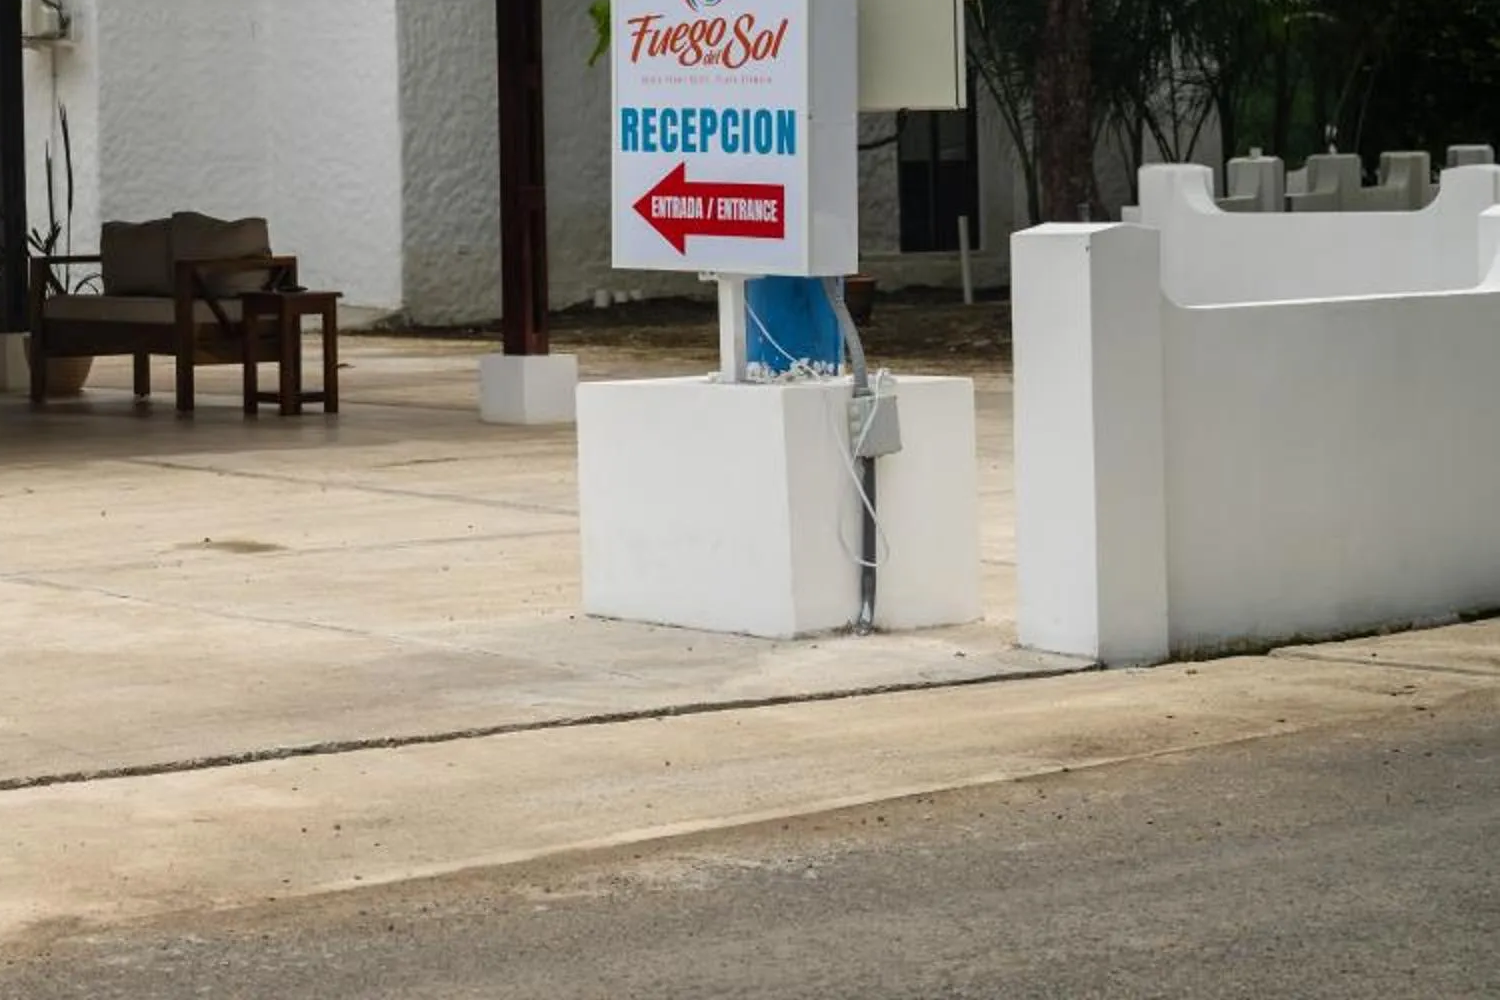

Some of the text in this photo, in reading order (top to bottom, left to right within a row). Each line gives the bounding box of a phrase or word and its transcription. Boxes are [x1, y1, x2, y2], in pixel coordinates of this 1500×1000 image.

[627, 13, 789, 69] Fuego del Sol
[621, 107, 797, 155] RECEPCION
[651, 195, 704, 219] ENTRADA
[717, 196, 778, 222] ENTRANCE
